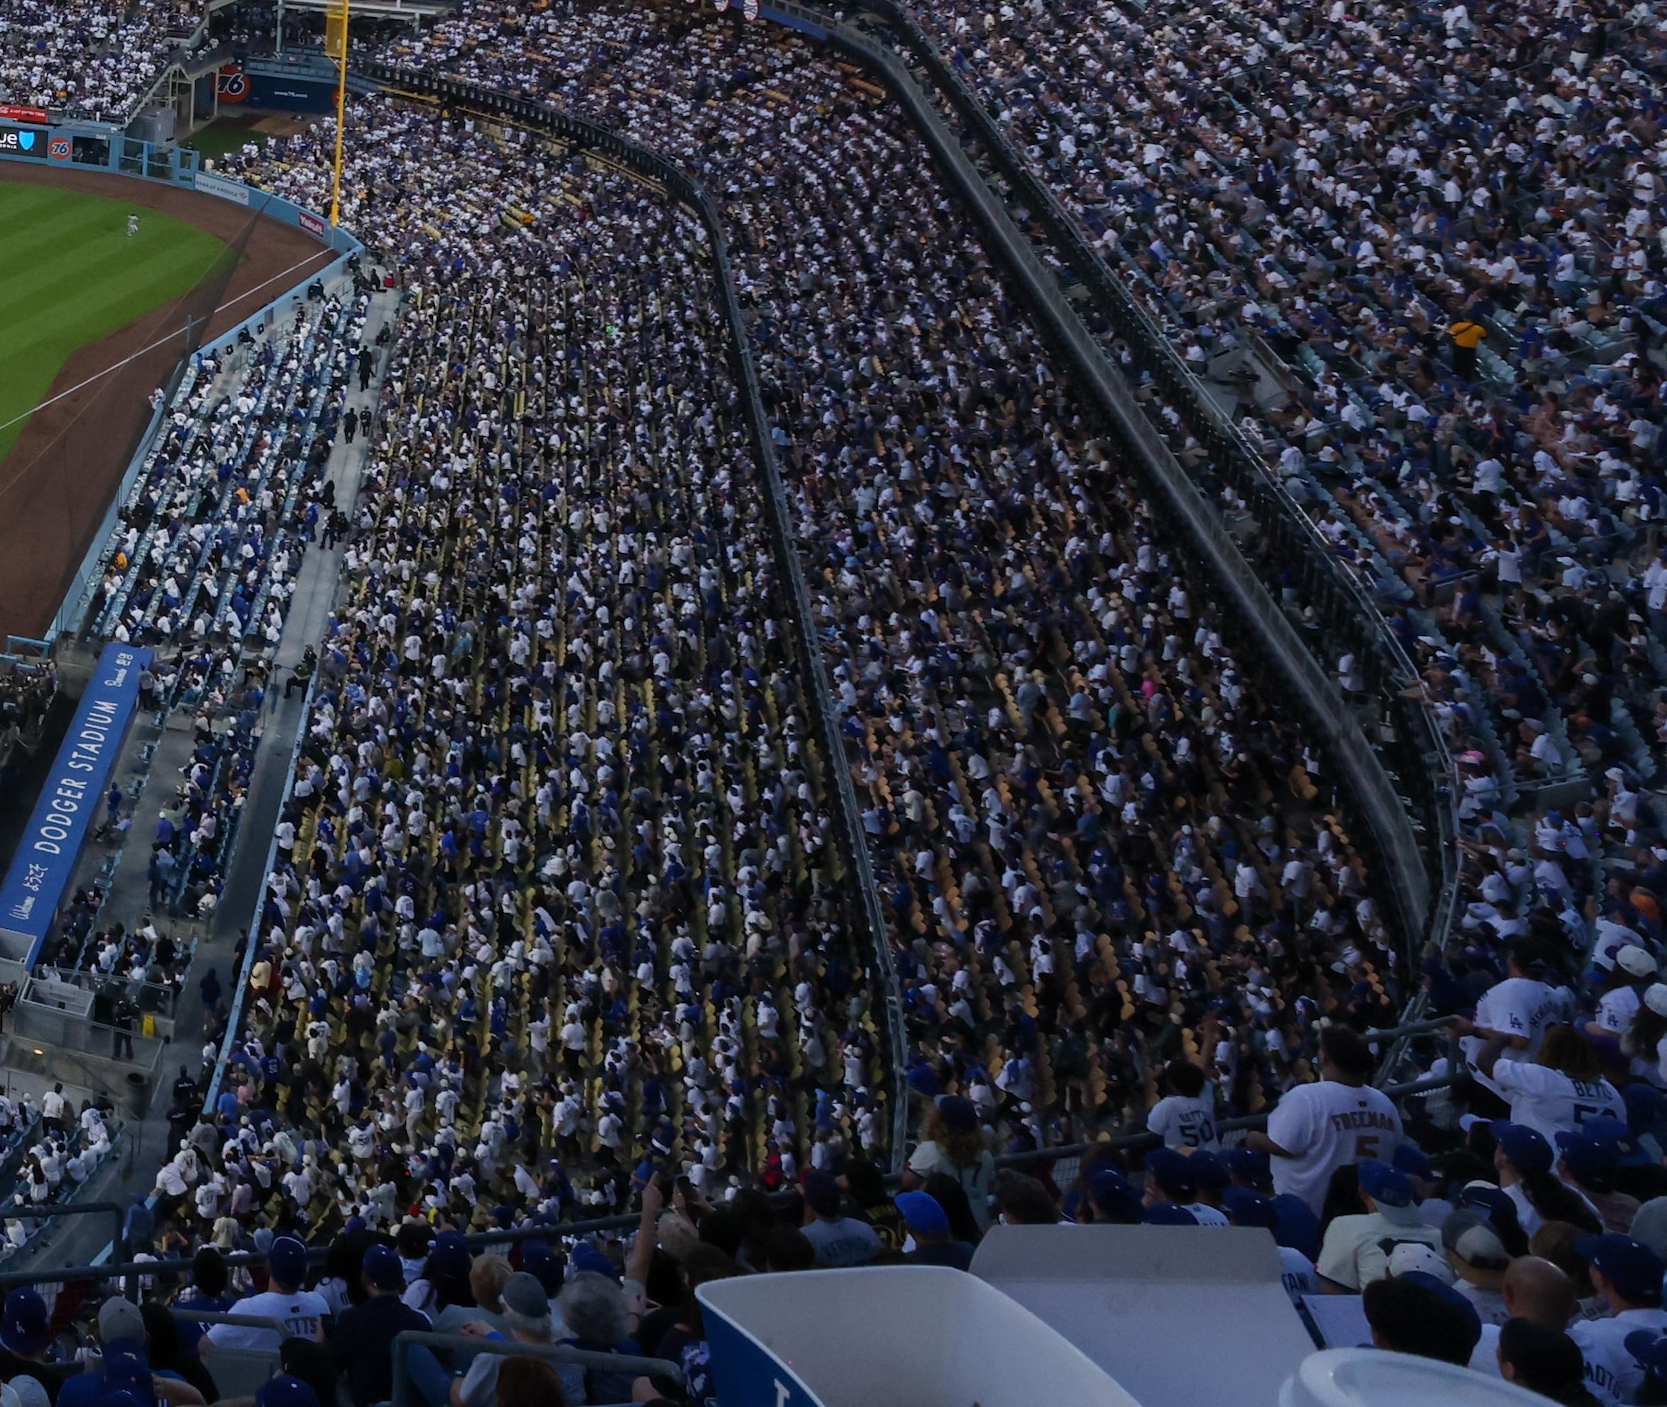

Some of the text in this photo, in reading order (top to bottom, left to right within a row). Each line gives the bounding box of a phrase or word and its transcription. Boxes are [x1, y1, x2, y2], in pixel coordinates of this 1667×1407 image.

[218, 73, 245, 95] 76
[51, 142, 70, 154] 76
[299, 214, 324, 236] Yakult
[34, 777, 87, 855] DODGER
[68, 699, 118, 773] STADIUM
[1330, 1111, 1395, 1132] FREEMAN
[1178, 1119, 1215, 1147] 50
[1355, 1135, 1380, 1158] 5
